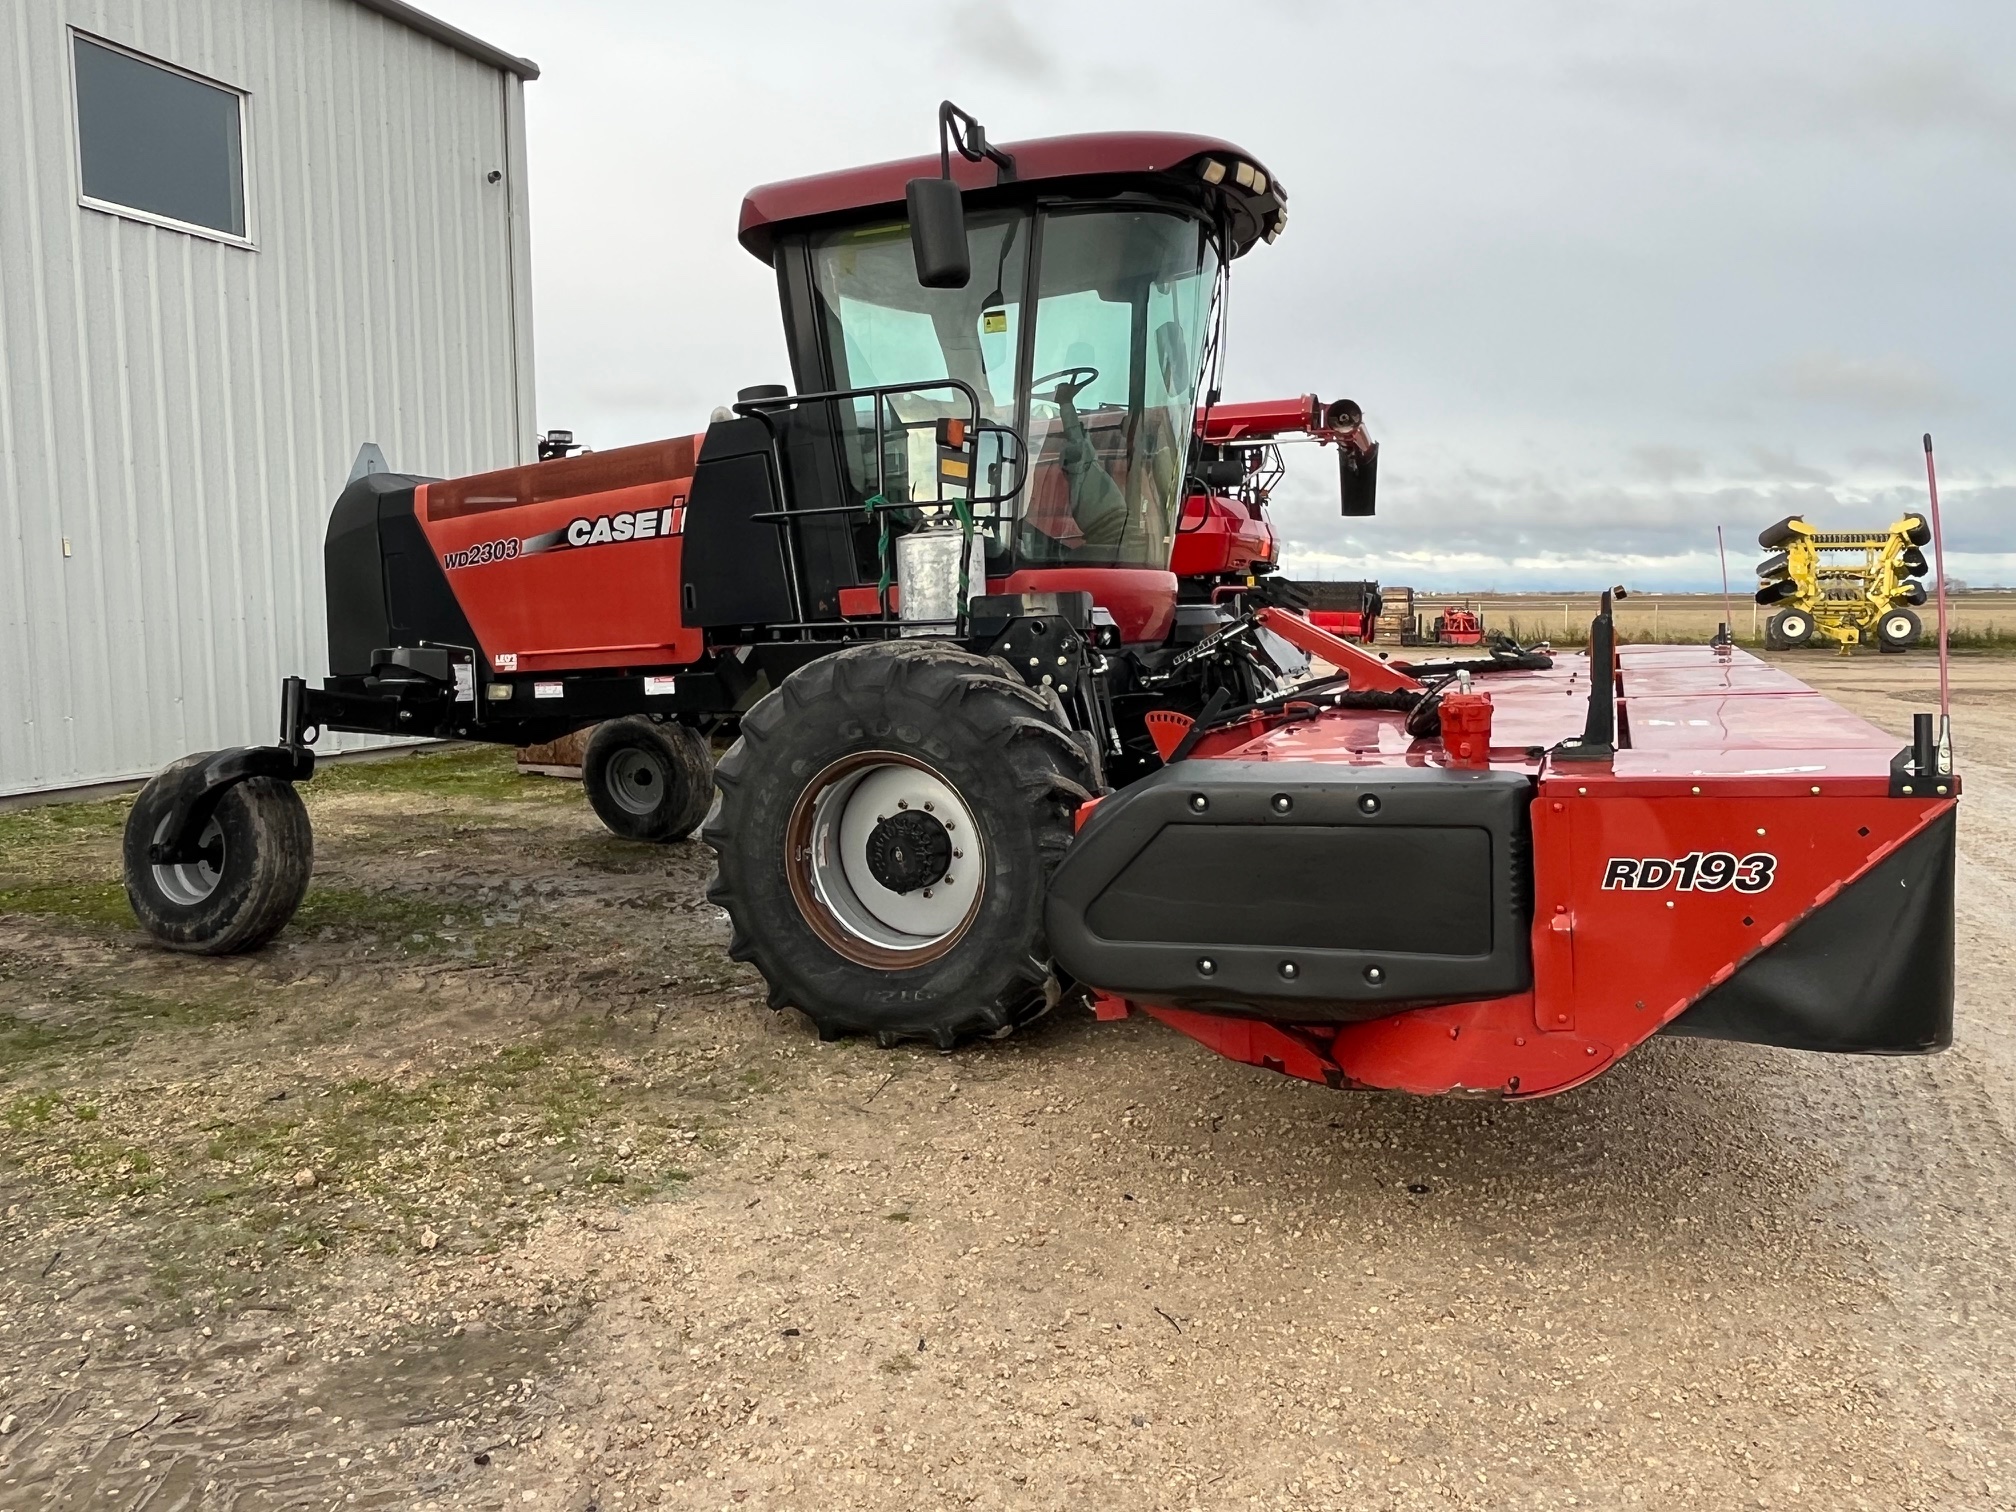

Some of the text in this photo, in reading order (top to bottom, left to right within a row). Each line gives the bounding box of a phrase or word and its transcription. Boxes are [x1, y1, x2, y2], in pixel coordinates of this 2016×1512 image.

[567, 509, 659, 547] CASE
[443, 536, 520, 571] WD2303
[1601, 852, 1778, 894] RD193
